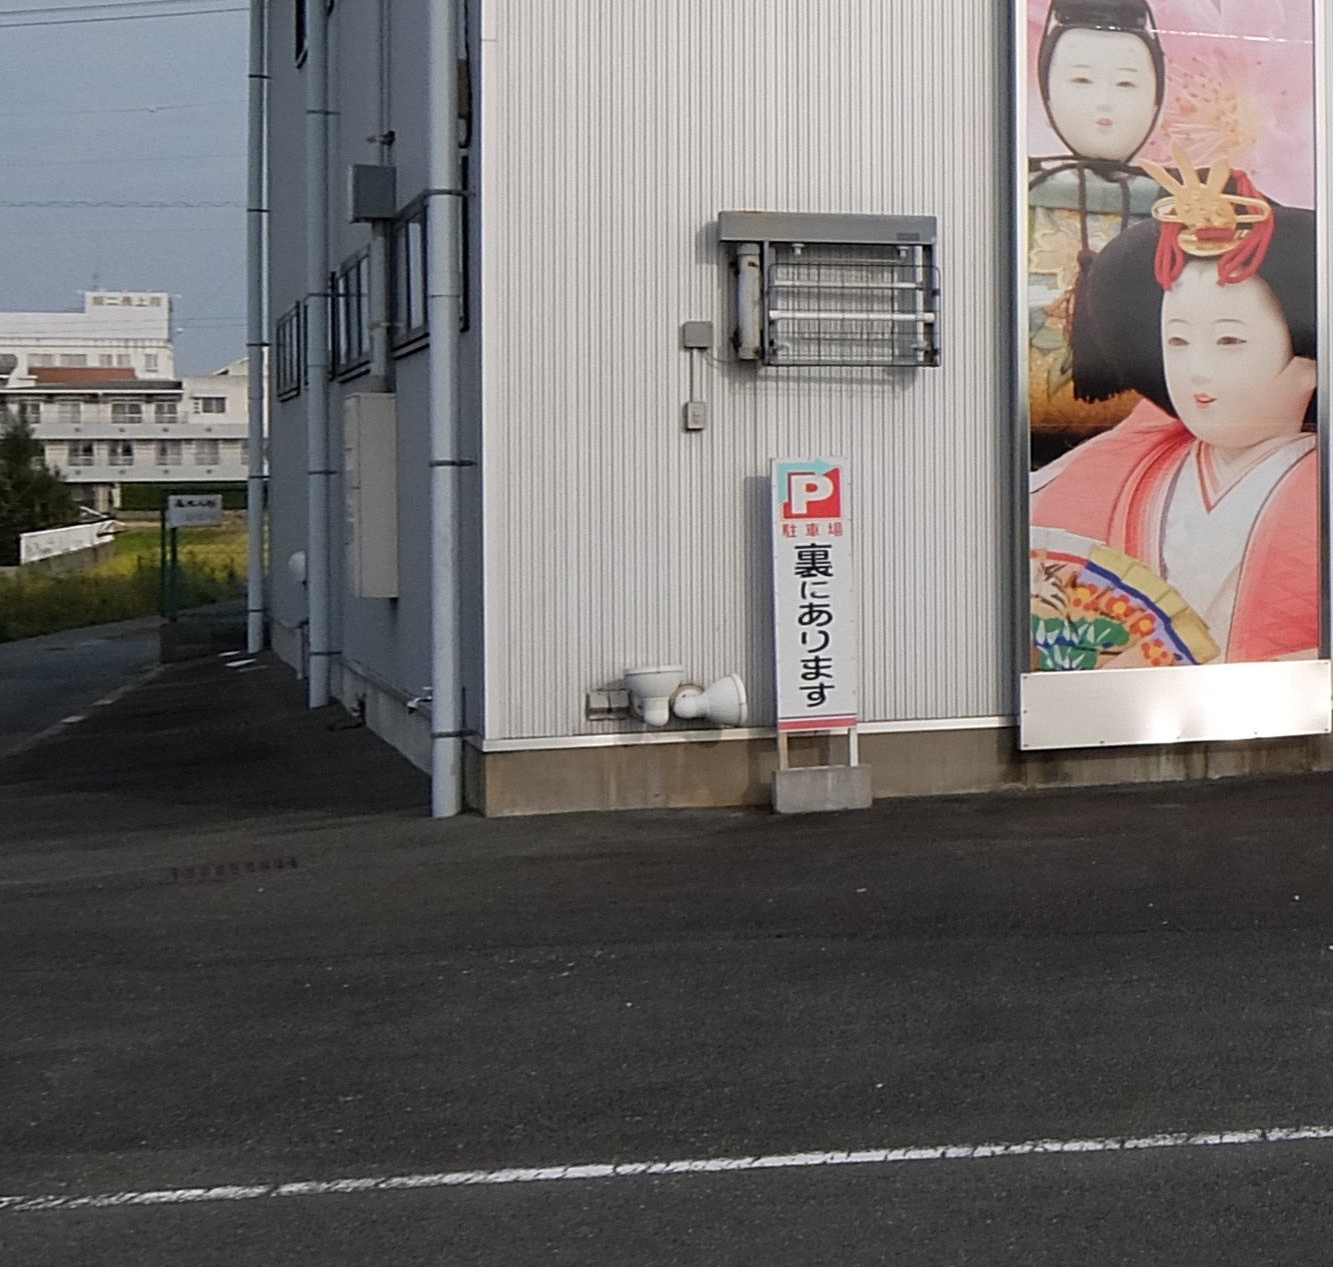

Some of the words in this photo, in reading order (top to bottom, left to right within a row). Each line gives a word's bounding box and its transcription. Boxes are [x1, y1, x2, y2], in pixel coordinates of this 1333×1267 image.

[790, 475, 834, 515] P
[783, 523, 843, 537] 駐車場
[794, 542, 835, 707] 裏にあります
